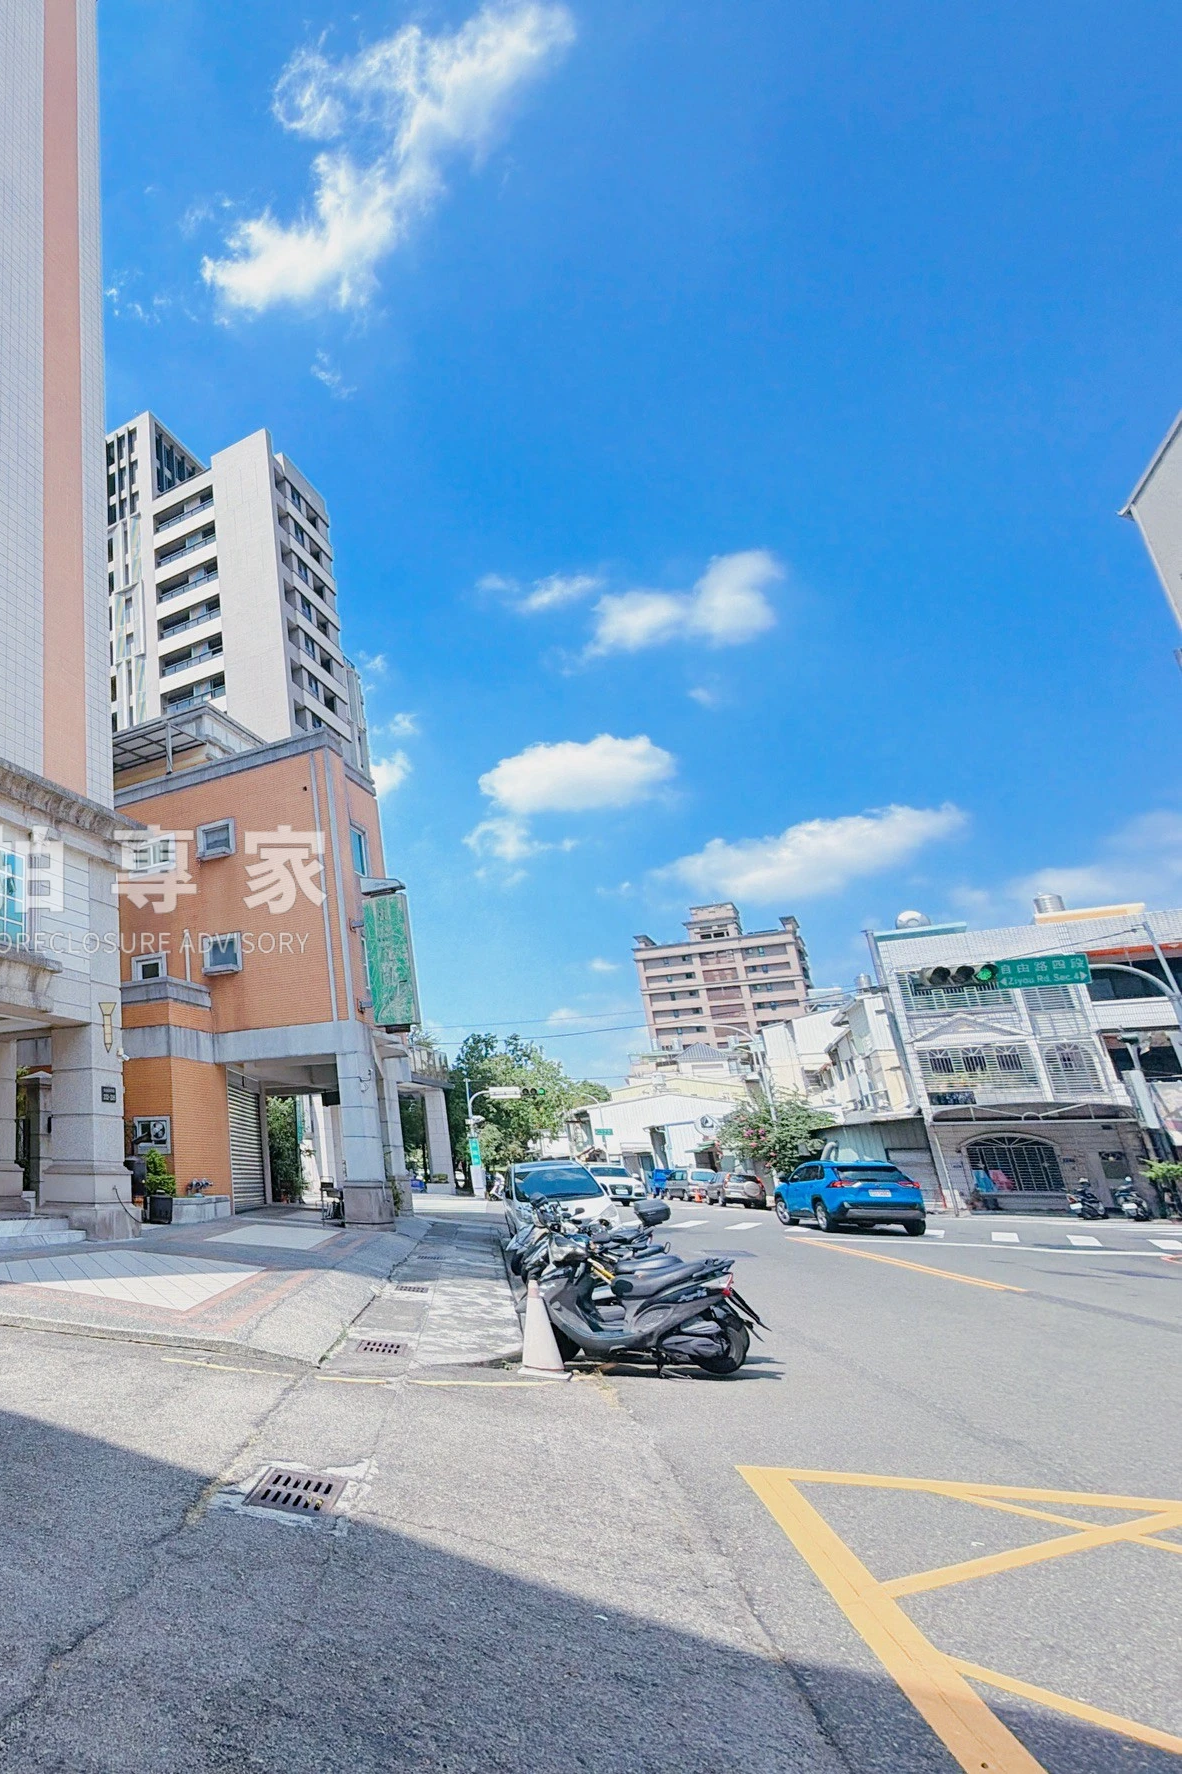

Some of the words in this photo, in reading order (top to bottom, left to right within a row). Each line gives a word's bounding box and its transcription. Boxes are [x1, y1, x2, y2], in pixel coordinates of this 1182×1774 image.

[1001, 958, 1085, 974] 自由路四段
[1008, 975, 1035, 987] Ziyou
